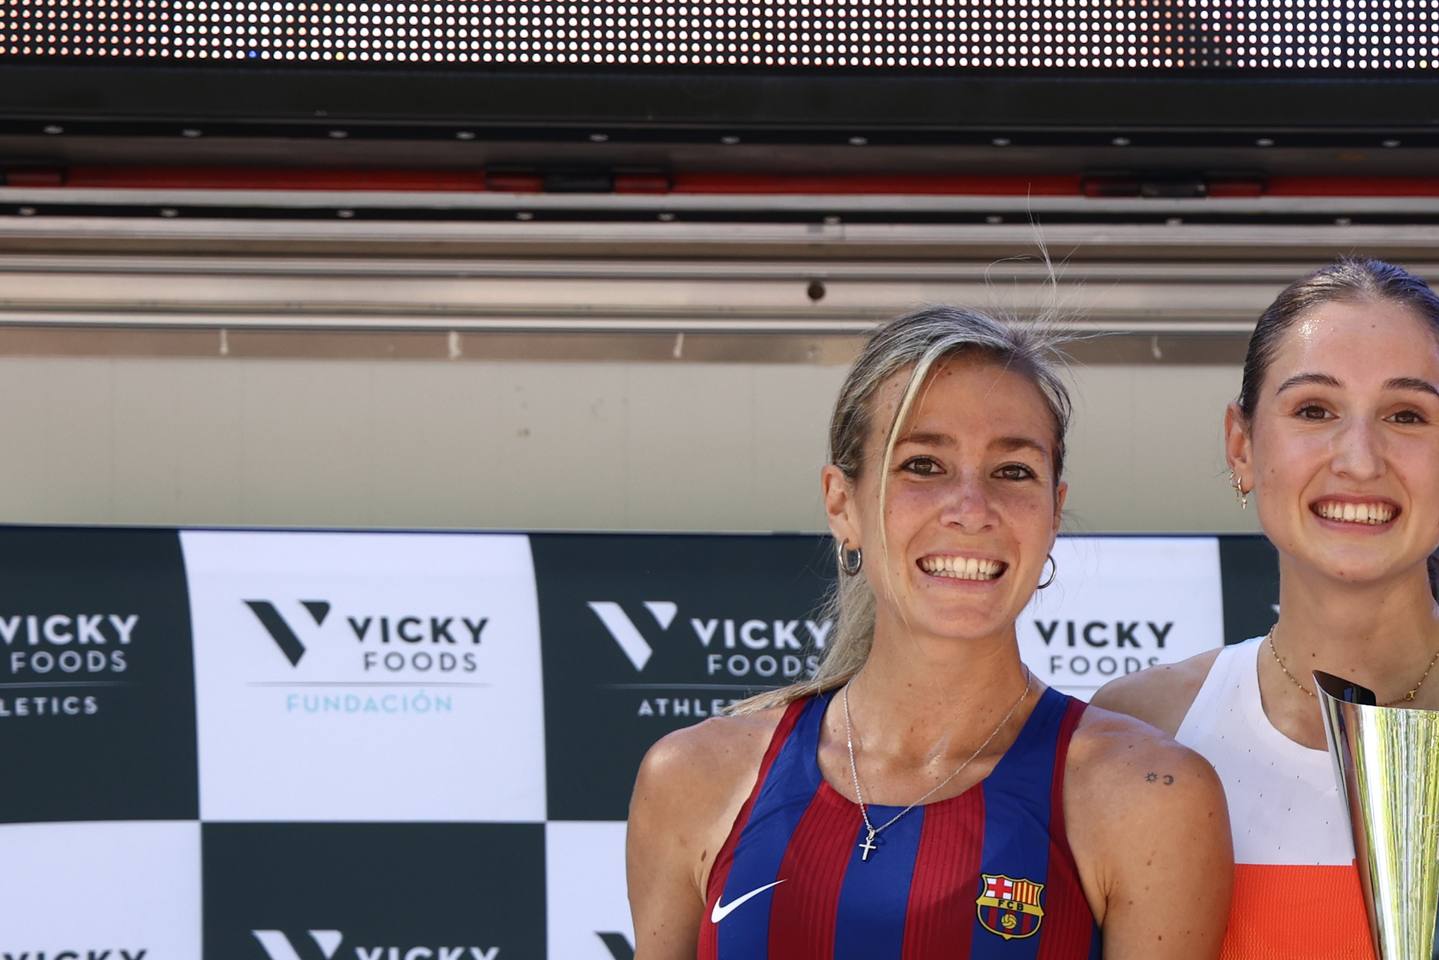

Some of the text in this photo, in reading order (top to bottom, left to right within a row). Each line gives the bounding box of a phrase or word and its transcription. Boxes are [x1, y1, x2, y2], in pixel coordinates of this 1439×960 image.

[0, 615, 139, 645] VICKY
[348, 617, 487, 644] VICKY
[691, 619, 832, 648] VICKY
[1034, 621, 1174, 648] VICKY
[11, 650, 127, 673] FOODS
[364, 652, 477, 672] FOODS
[708, 654, 821, 677] FOODS
[0, 695, 99, 717] LETICS
[286, 689, 453, 713] FUNDACIÓN
[637, 698, 738, 717] ATHLE
[998, 900, 1024, 911] FCB
